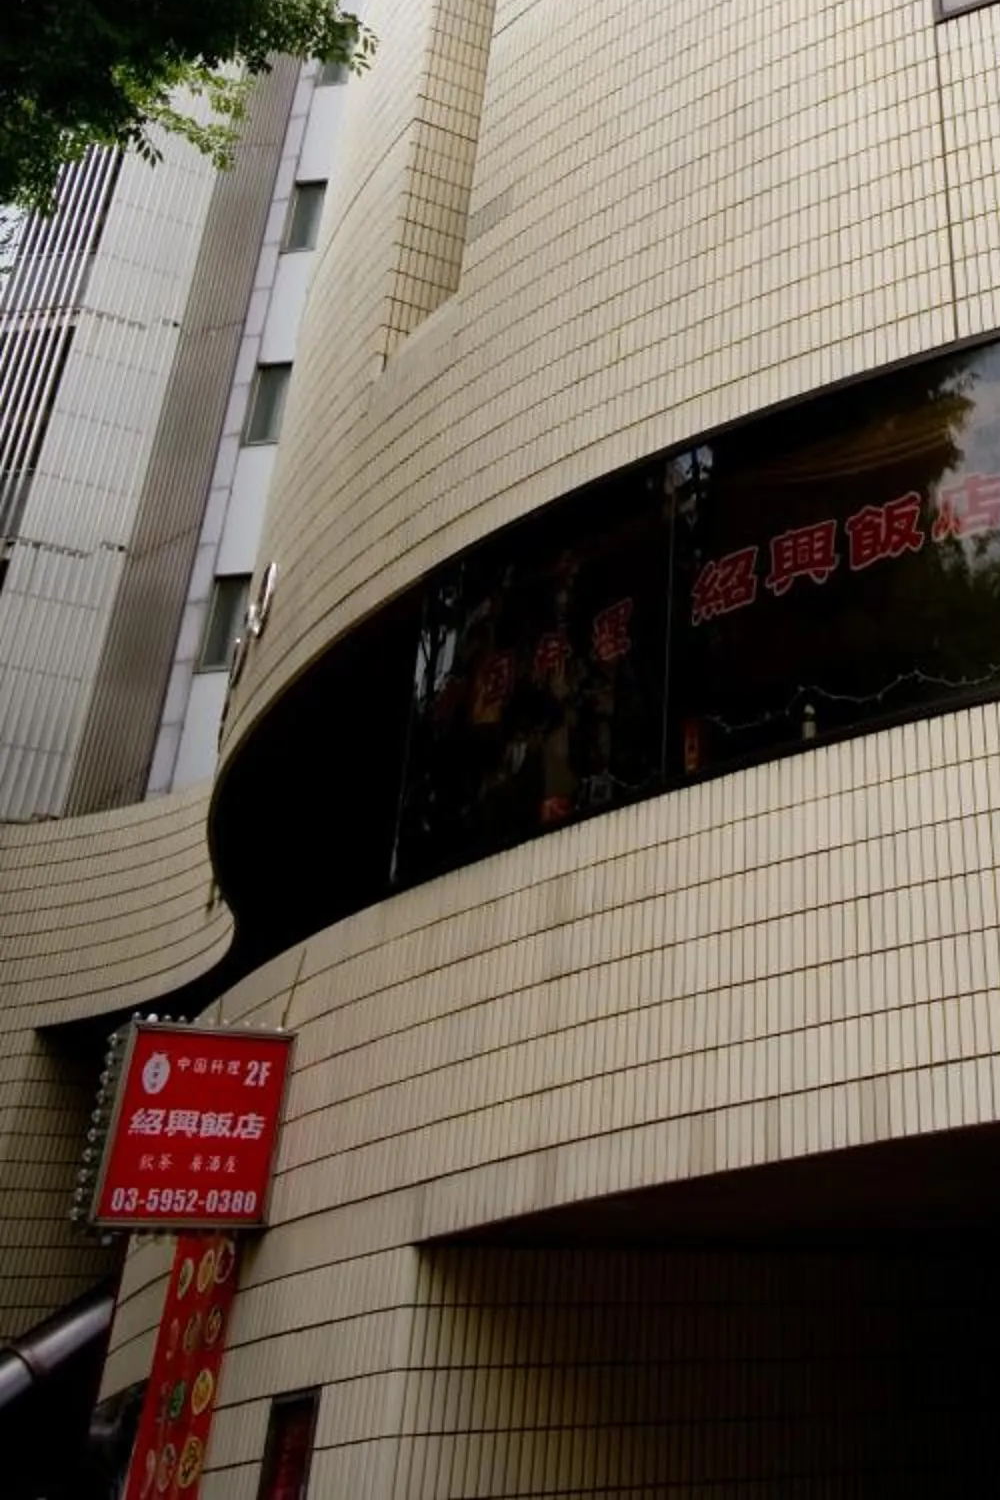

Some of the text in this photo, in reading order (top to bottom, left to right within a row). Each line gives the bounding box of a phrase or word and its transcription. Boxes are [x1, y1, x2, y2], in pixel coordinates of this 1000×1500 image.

[177, 1056, 242, 1075] 中国料理
[243, 1060, 272, 1087] 2F
[128, 1107, 267, 1141] 紹興飯店
[110, 1186, 258, 1214] 03-5952-0380
